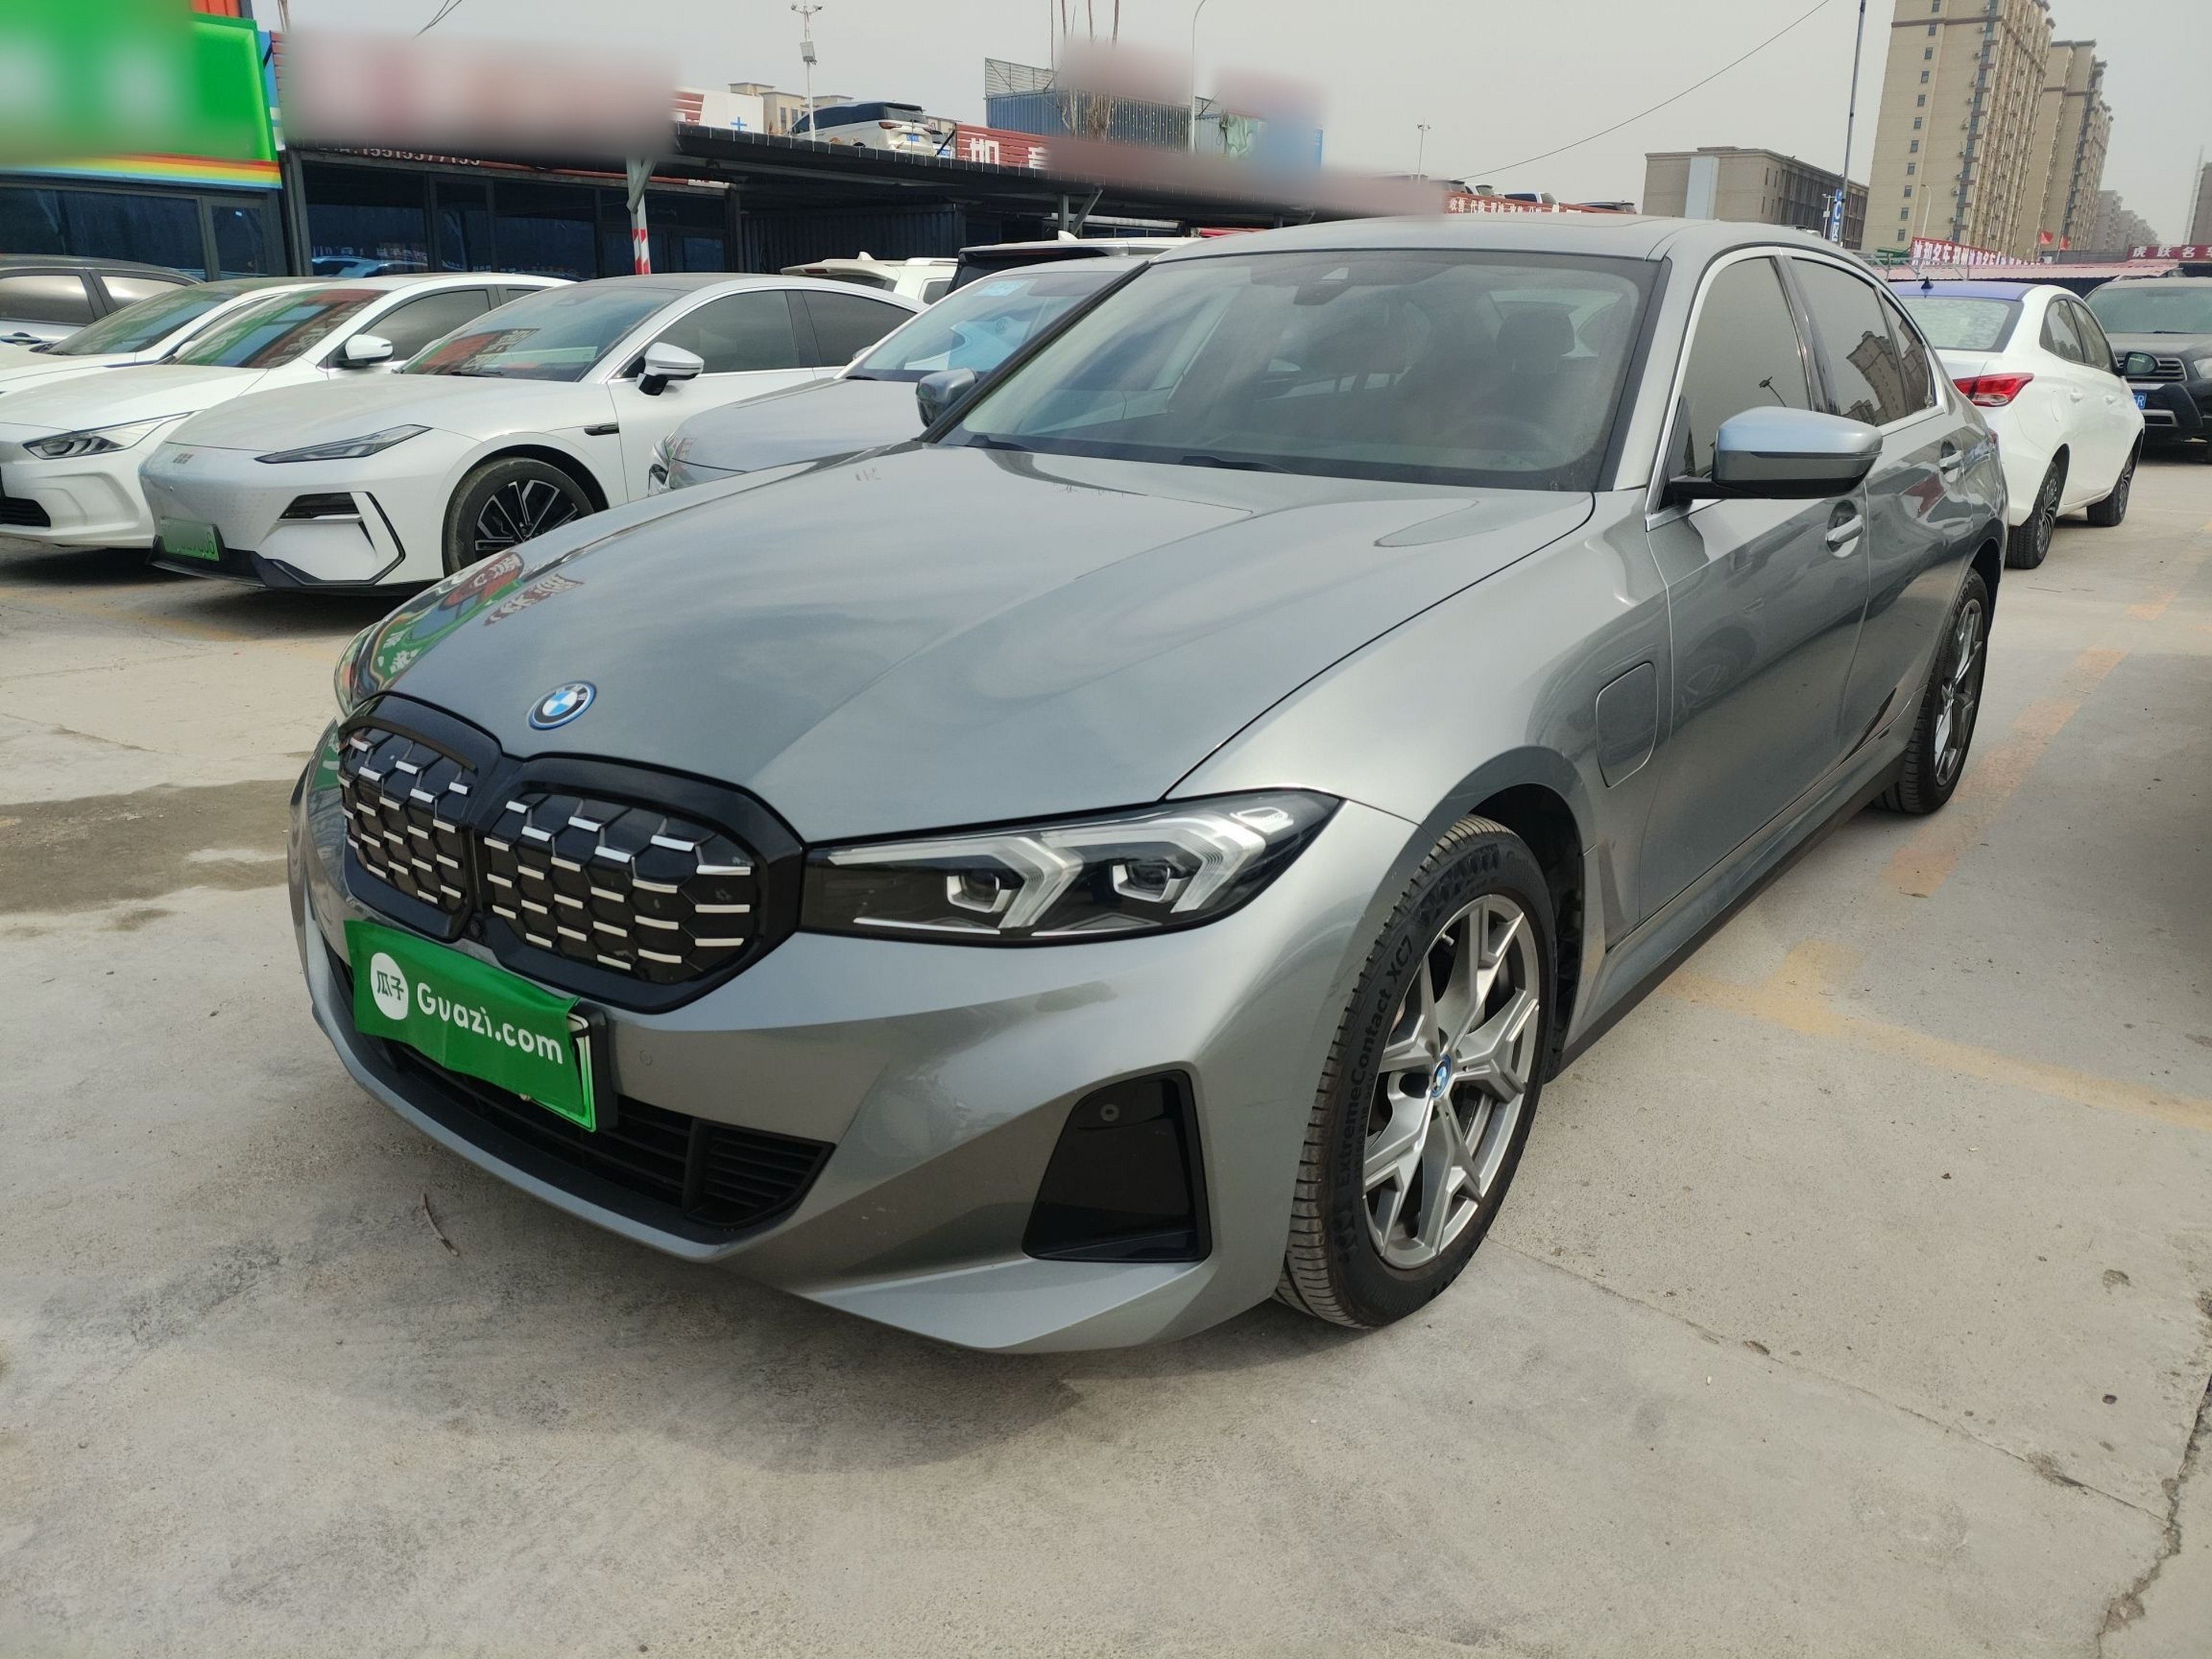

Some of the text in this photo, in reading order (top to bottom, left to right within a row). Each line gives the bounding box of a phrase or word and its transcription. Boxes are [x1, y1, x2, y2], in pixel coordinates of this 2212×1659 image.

[376, 970, 404, 1001] 瓜子
[417, 982, 563, 1064] Guazi.com
[1337, 935, 1412, 1188] ExtremeContact XC7
